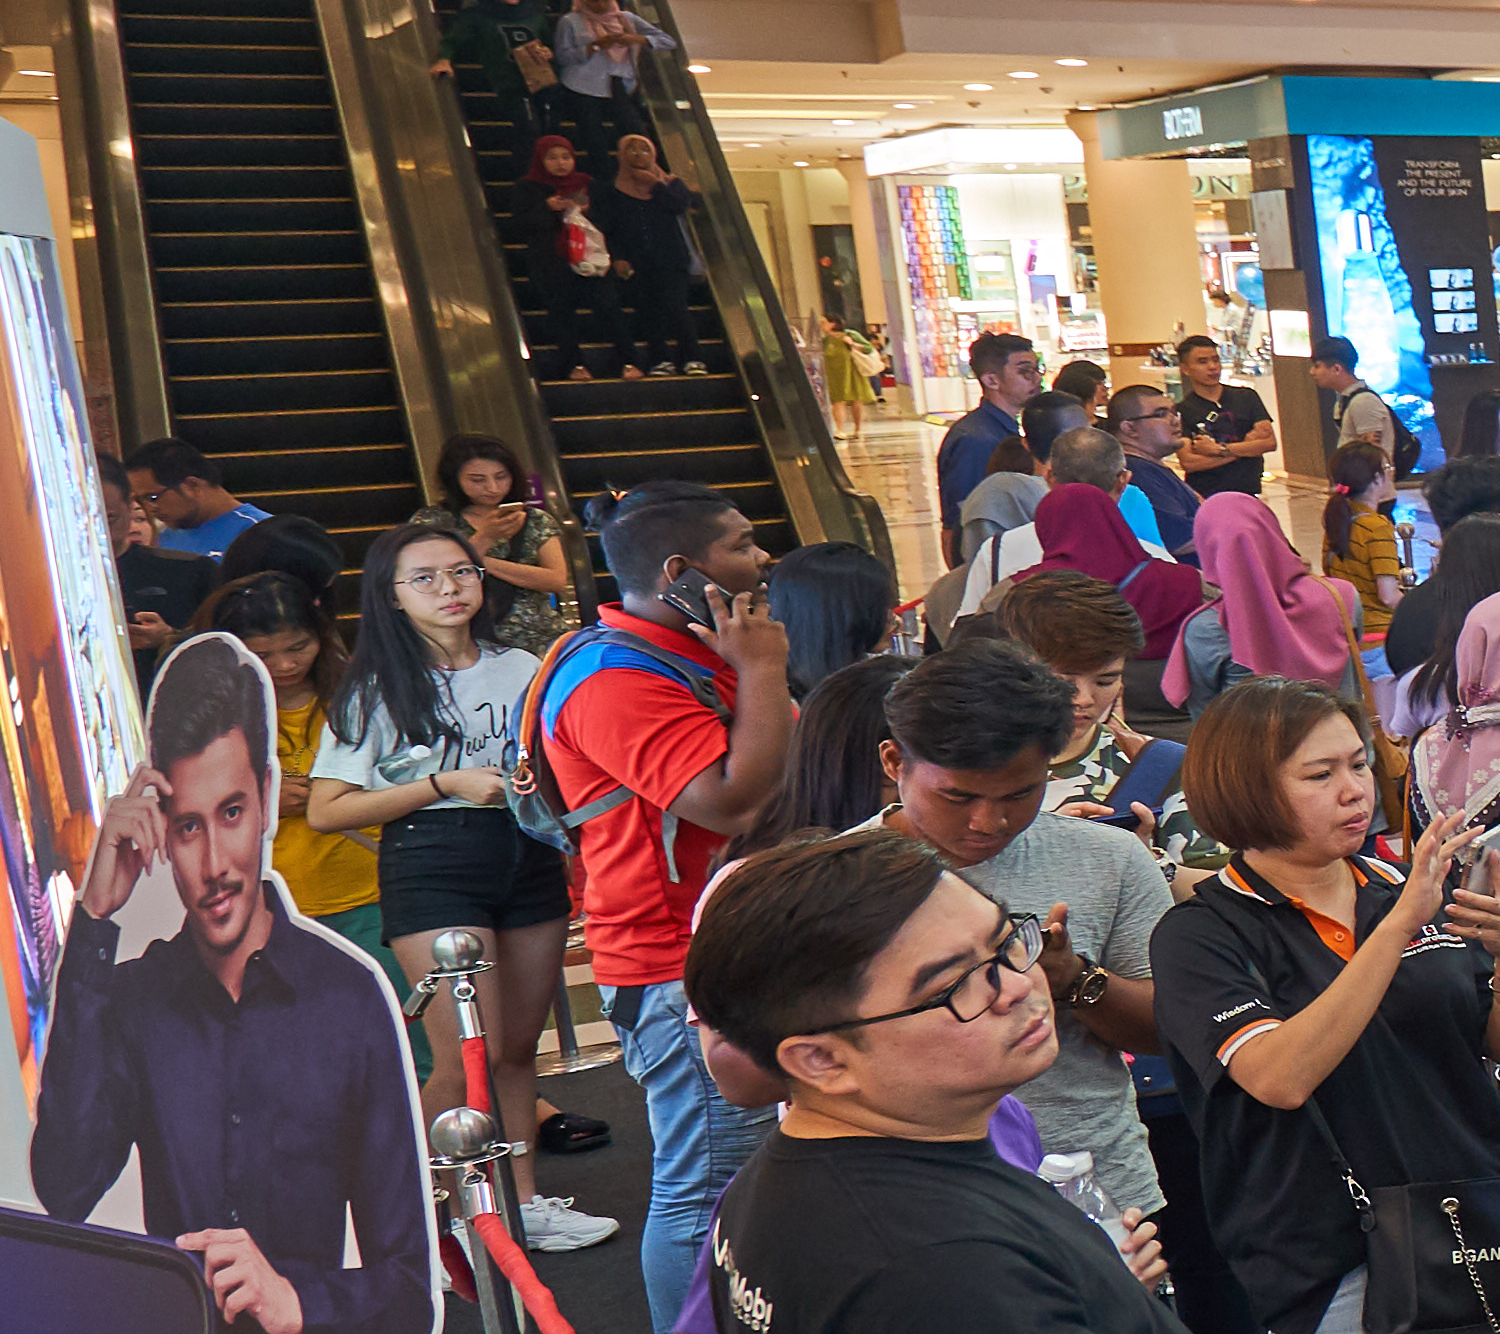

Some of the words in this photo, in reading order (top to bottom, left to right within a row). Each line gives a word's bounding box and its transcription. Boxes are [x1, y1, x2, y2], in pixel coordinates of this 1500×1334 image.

[1404, 169, 1422, 179] THE
[1420, 178, 1437, 188] THE
[1403, 187, 1418, 197] OF
[1419, 187, 1446, 197] YOUR
[1213, 999, 1256, 1024] Wisdom
